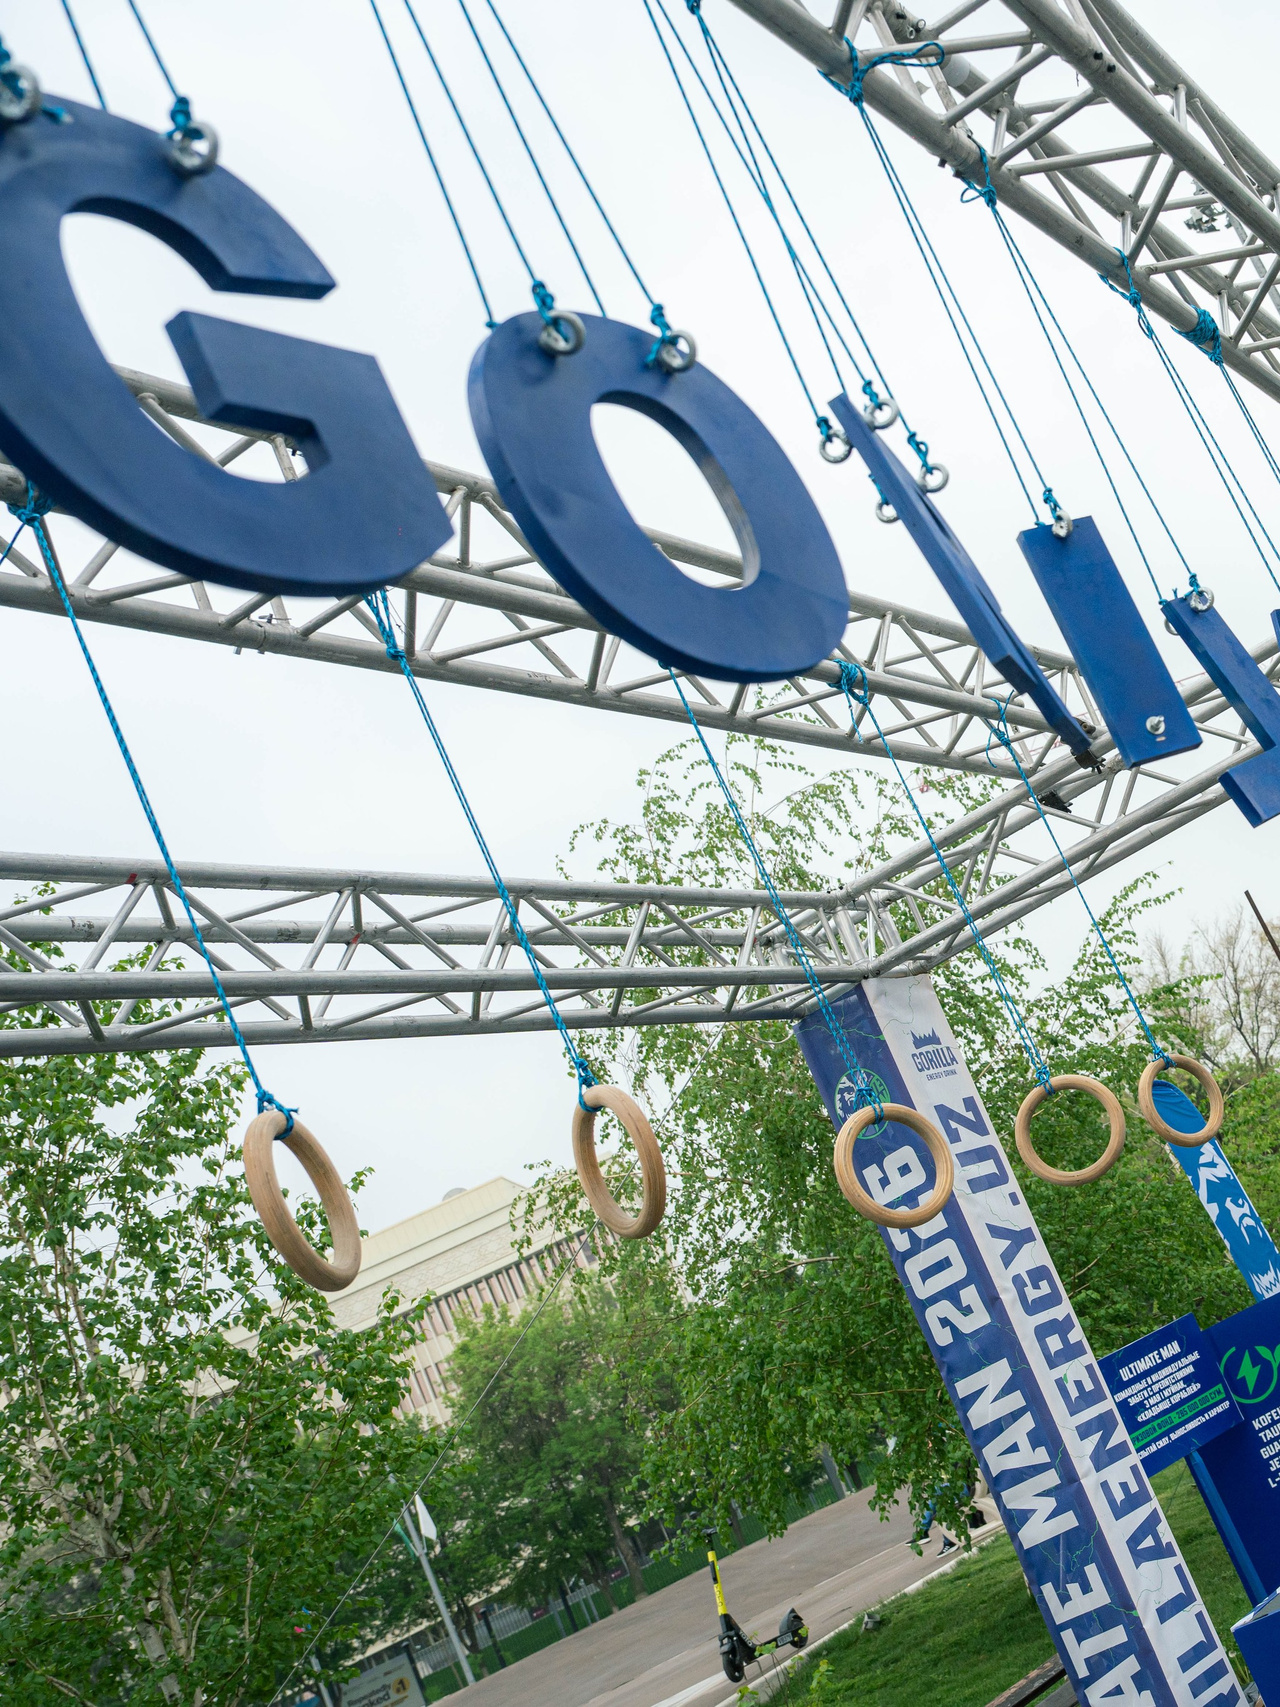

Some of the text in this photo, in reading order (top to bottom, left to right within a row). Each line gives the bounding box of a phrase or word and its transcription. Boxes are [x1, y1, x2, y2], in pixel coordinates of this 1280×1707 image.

[911, 1045, 959, 1073] GORILLA
[926, 1069, 957, 1081] ENERGY DRINK
[862, 1145, 993, 1349] 2026
[1119, 1340, 1181, 1381] ULTIMATE MAN
[1130, 1424, 1158, 1446] РИЗОВОЙ
[955, 1358, 1079, 1552] MAN
